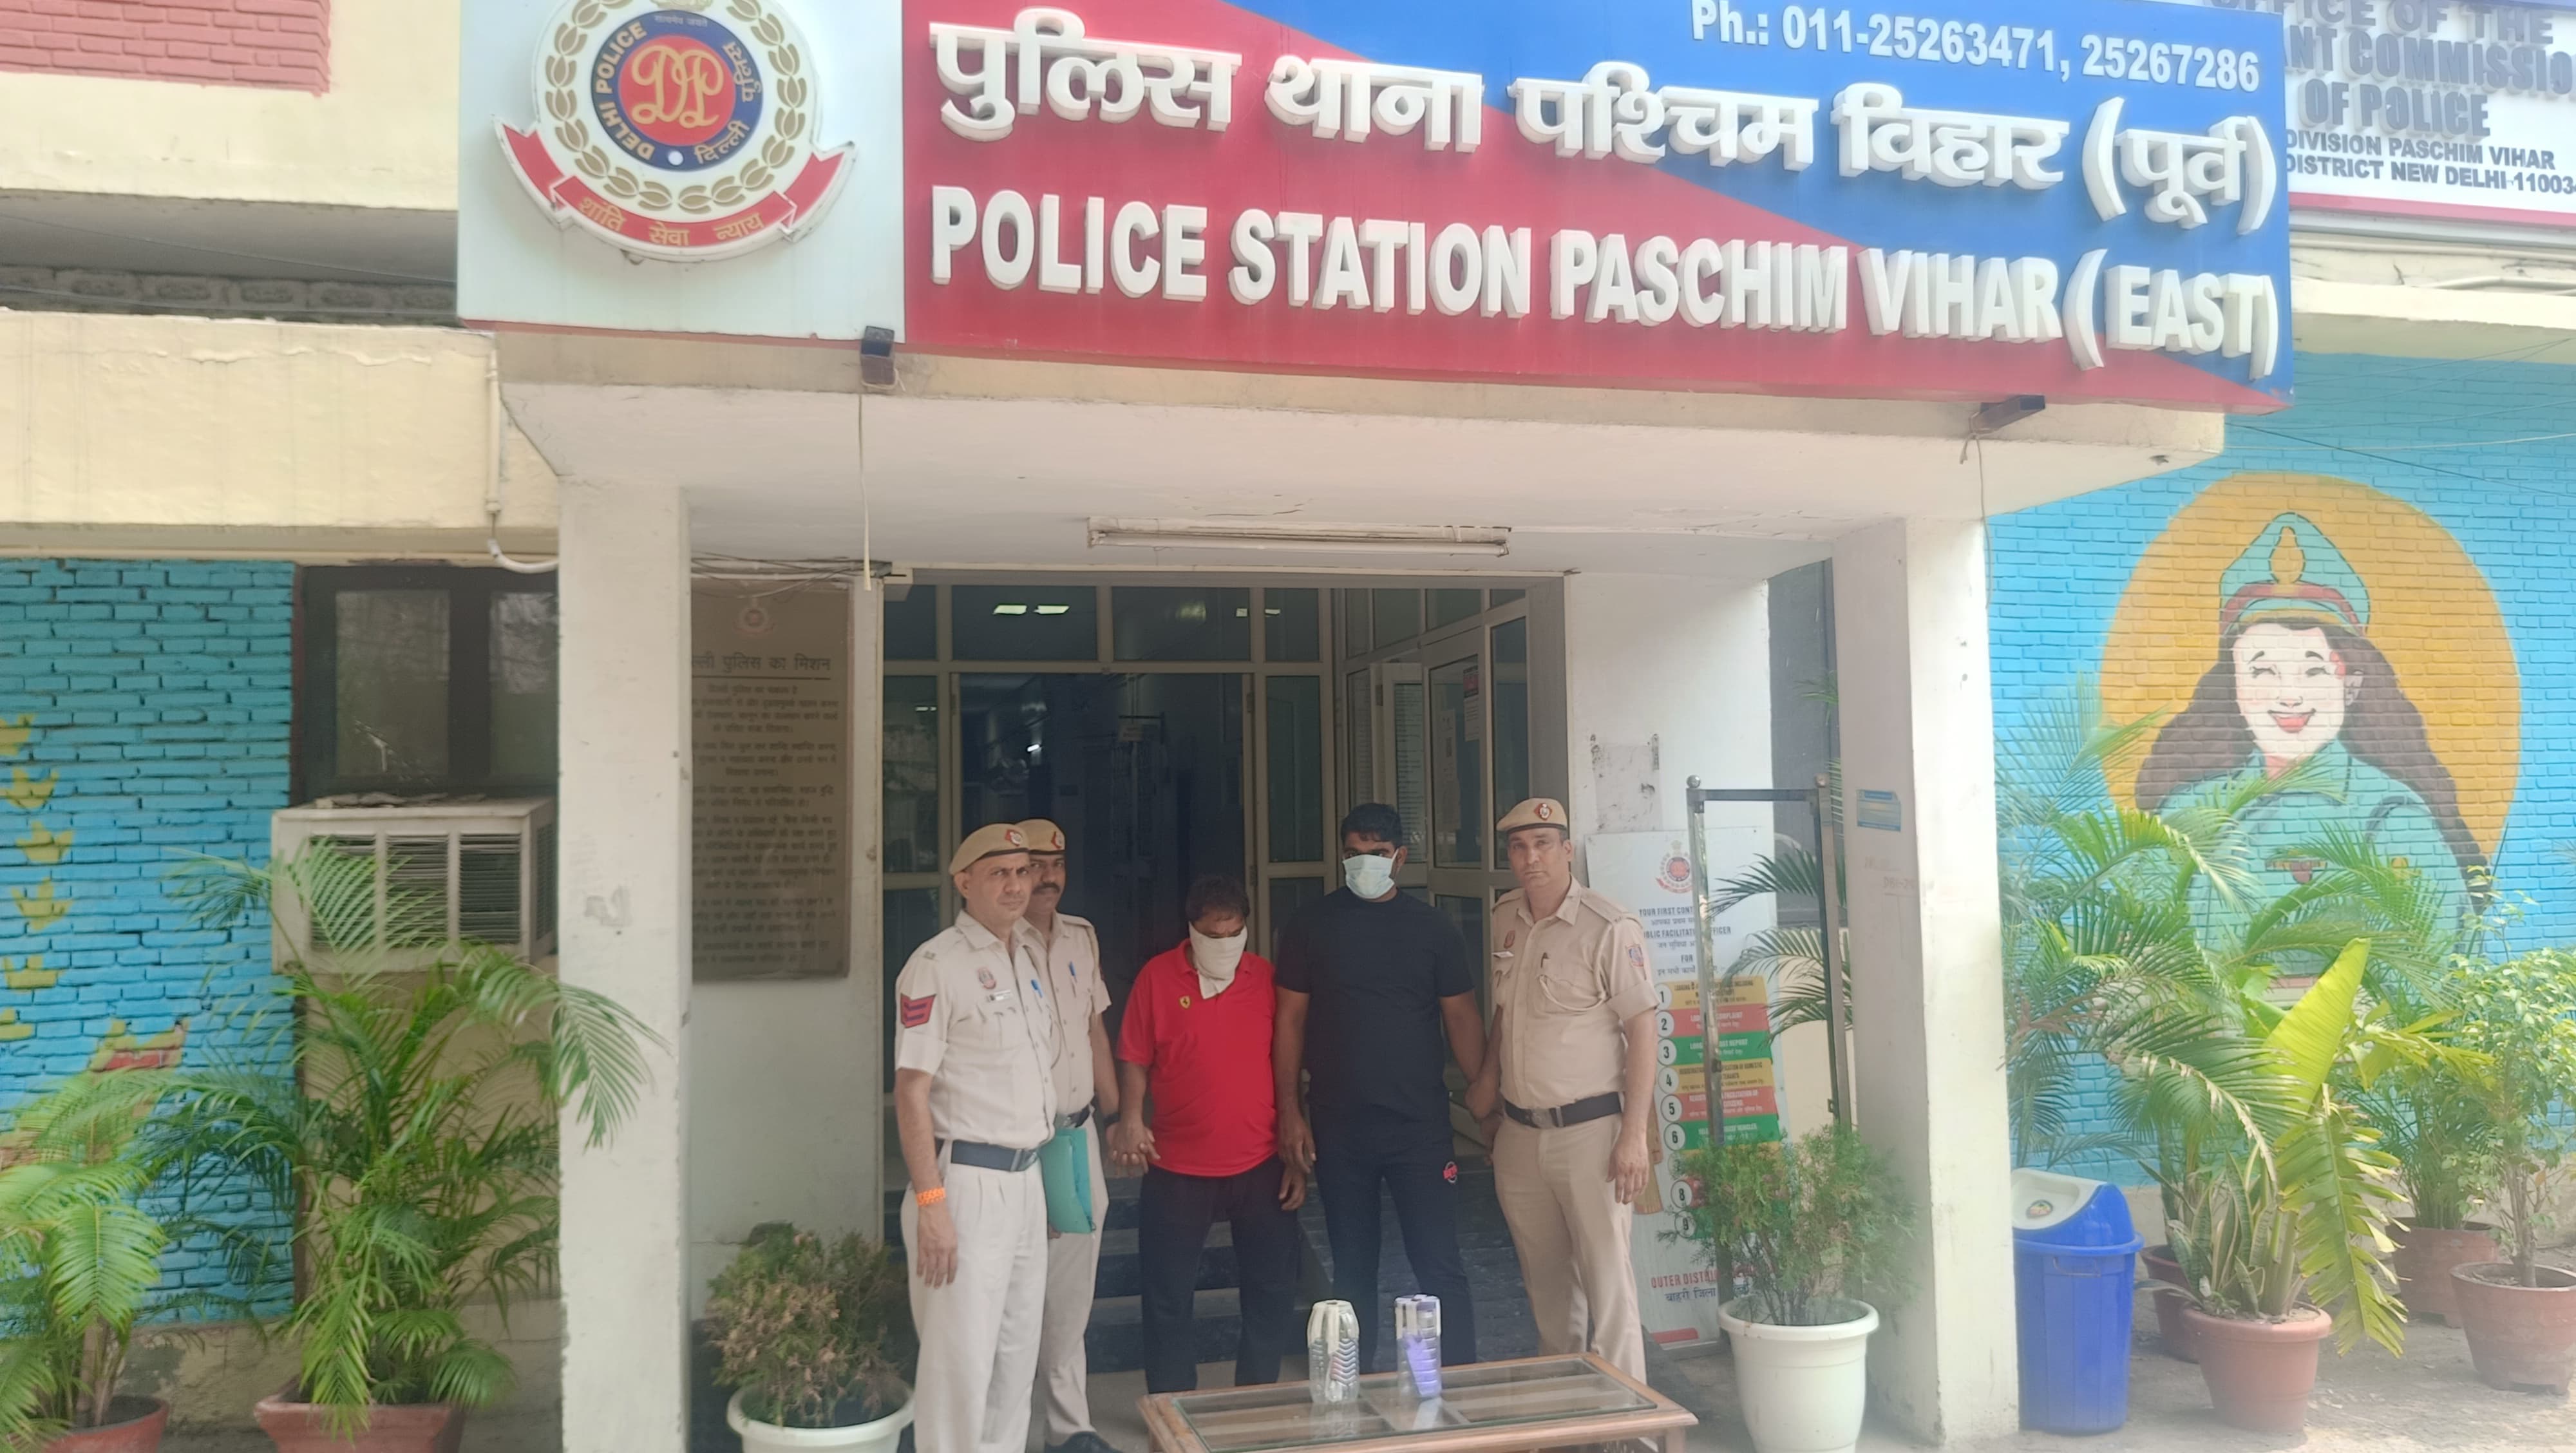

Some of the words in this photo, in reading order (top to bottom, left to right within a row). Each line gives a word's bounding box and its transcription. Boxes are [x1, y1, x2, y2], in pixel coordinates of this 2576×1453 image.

[2468, 4, 2553, 44] THE
[596, 21, 647, 94] POLICE
[1783, 5, 2070, 82] 011-25263471,
[2081, 34, 2260, 91] 25267286
[694, 120, 750, 164] दिल्ली
[722, 41, 762, 102] पुलिस
[929, 6, 1242, 142] पुलिस
[1264, 55, 1484, 153] थाना
[1507, 61, 1819, 171] पश्चिम
[1830, 82, 2069, 190] विहार
[2304, 79, 2349, 125] OF
[2360, 84, 2490, 137] POLICE
[598, 101, 656, 160] DELHI
[2388, 137, 2483, 164] PASCHIM
[2488, 146, 2555, 170] VIHAR
[2391, 160, 2439, 184] NEW
[649, 222, 690, 246] सेवा
[713, 213, 764, 240] न्याय
[931, 185, 1208, 301] POLICE
[1228, 208, 1531, 319] STATION
[1550, 229, 1848, 334] PASCHIM
[1855, 248, 2063, 343] VIHAR
[1639, 907, 1656, 916] YOUR
[1657, 906, 1675, 915] FIRST
[1681, 954, 1693, 963] FOR
[1661, 1018, 1667, 1030] 2
[1663, 1046, 1669, 1059] 3
[1666, 1074, 1672, 1087] 4
[1669, 1103, 1674, 1115] 5
[1672, 1131, 1678, 1143] 6
[1679, 1188, 1685, 1201] 8
[1651, 1275, 1681, 1289] OUTER
